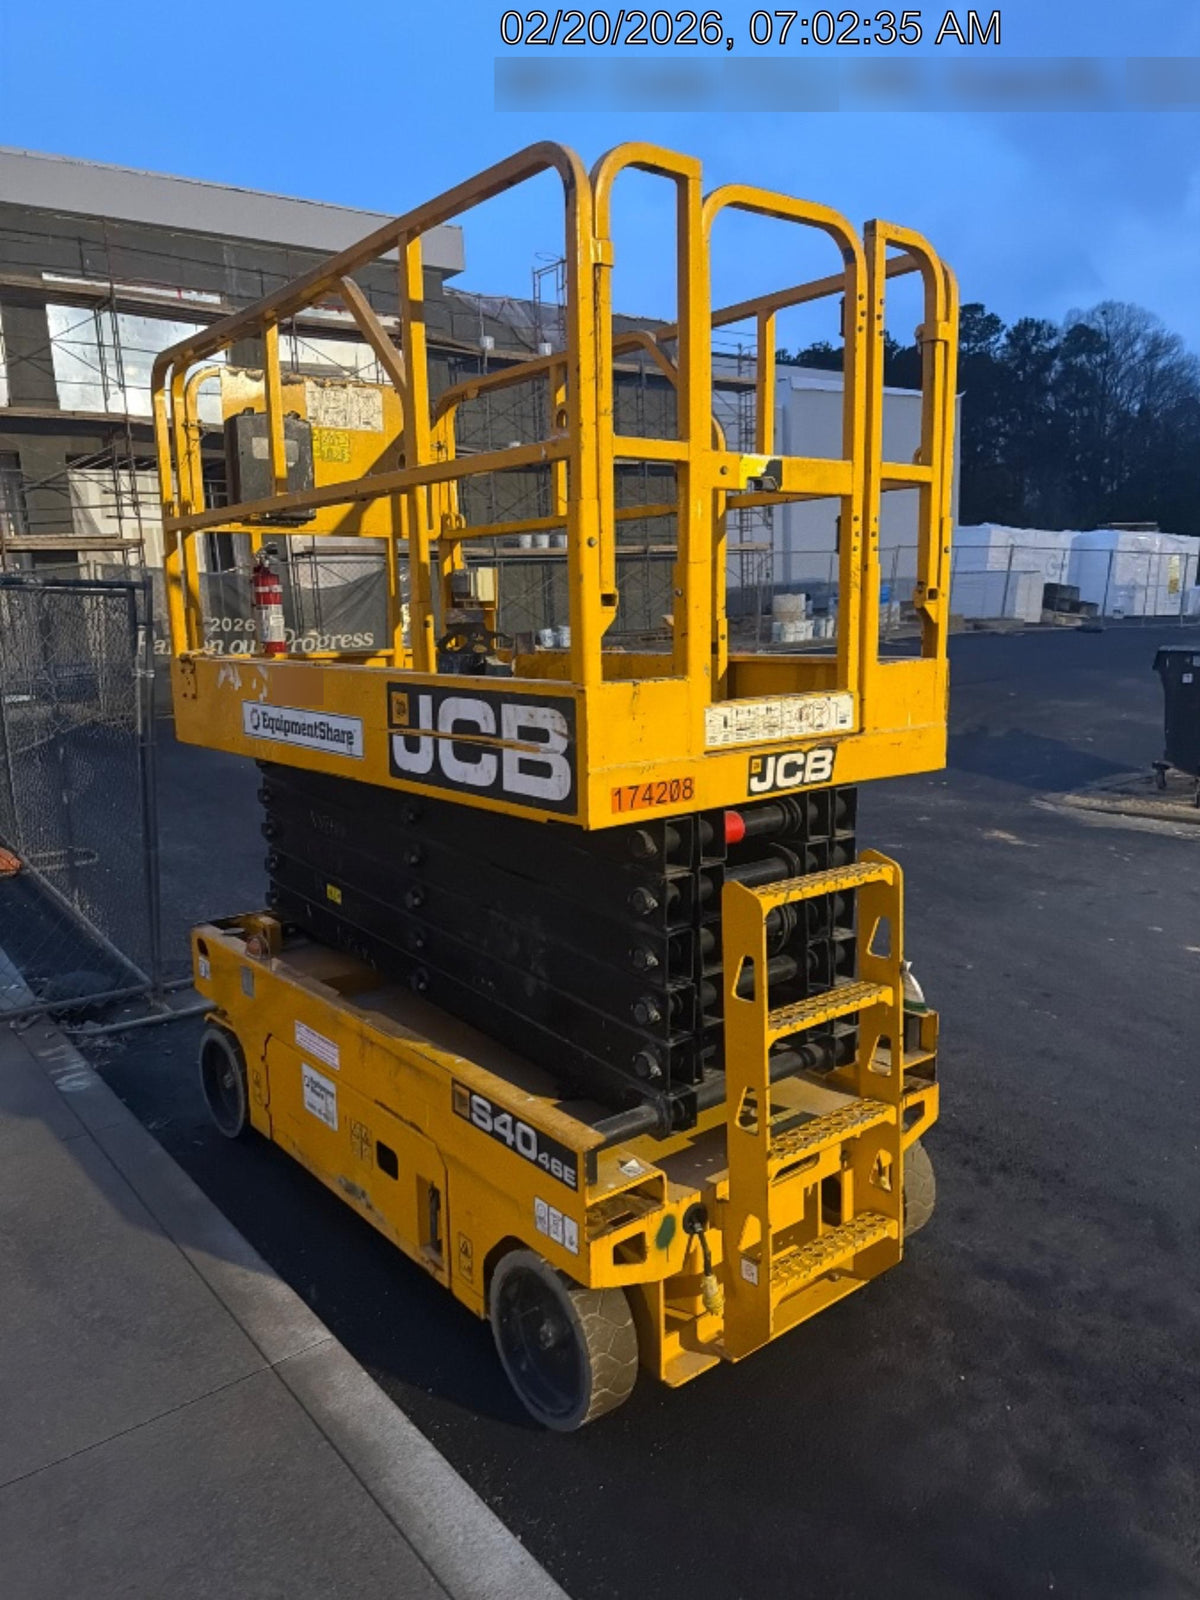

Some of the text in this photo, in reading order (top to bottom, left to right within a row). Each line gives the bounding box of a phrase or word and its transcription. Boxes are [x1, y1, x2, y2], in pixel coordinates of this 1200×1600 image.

[210, 618, 256, 632] 2026
[261, 711, 354, 745] EquipmentShare
[393, 695, 571, 800] JCB
[750, 748, 834, 793] JCB
[614, 777, 694, 812] 174208
